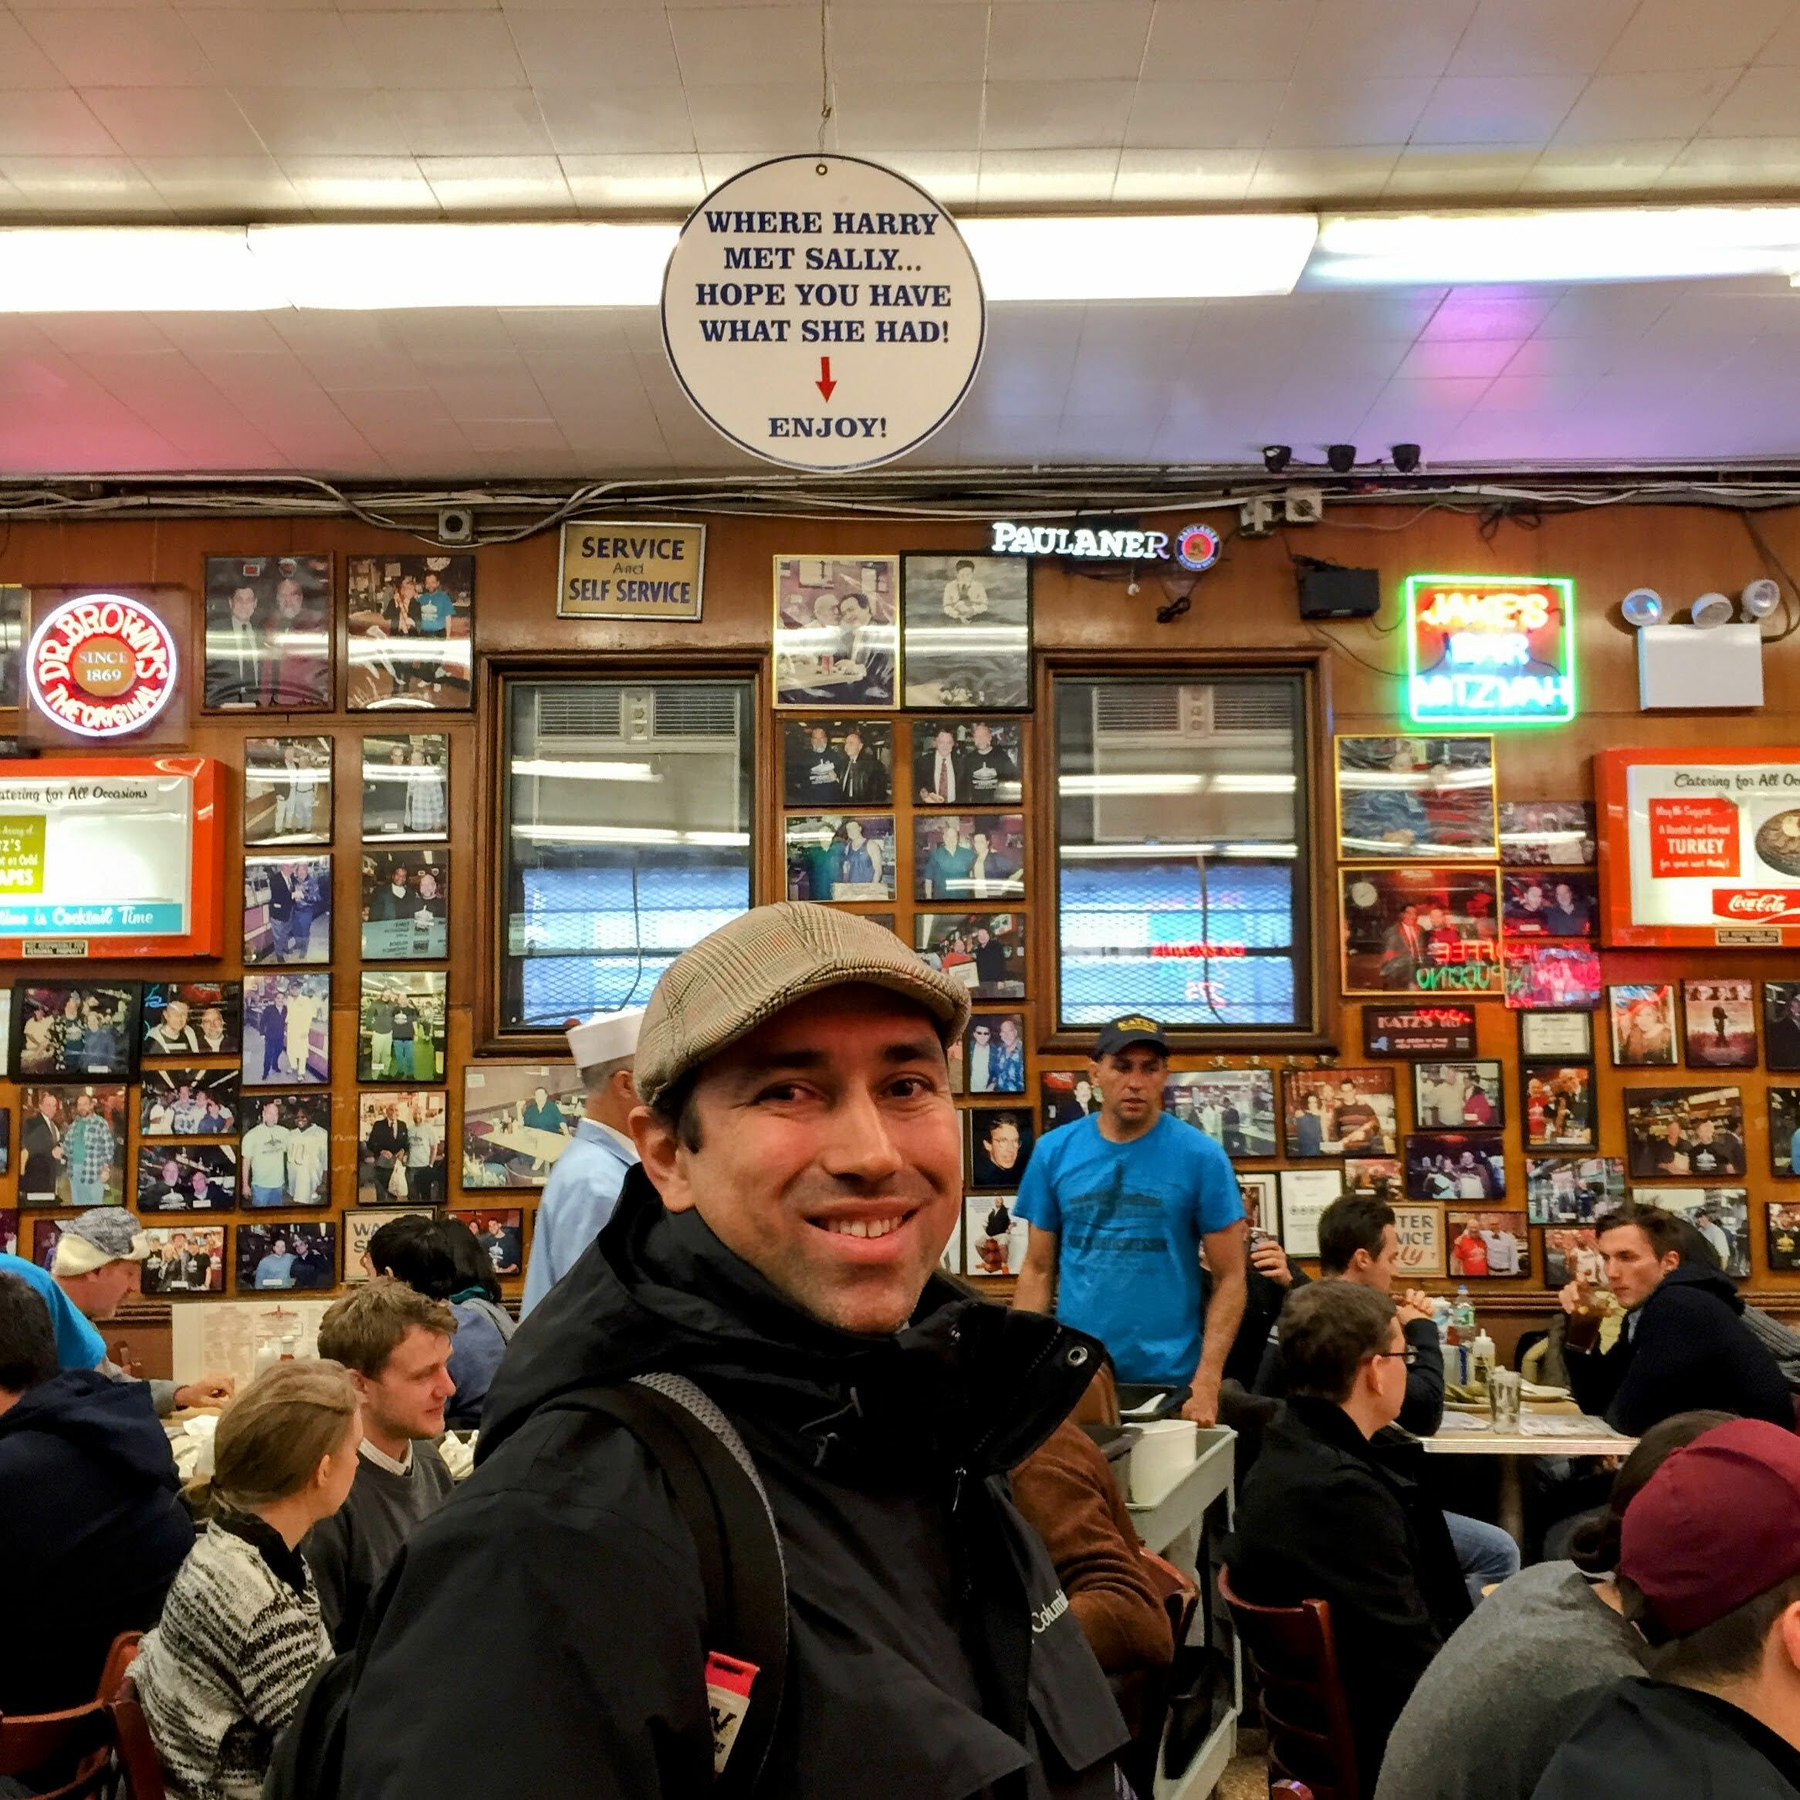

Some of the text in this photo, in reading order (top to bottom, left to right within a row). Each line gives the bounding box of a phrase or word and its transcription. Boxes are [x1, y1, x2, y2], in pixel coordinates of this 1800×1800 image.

[704, 211, 939, 235] WHERE HARRY
[724, 247, 921, 272] MET SALLY...
[695, 283, 951, 307] HOPE YOU HAVE
[699, 320, 949, 343] WHAT SHE HAD!
[768, 418, 887, 438] ENJOY!
[581, 536, 685, 560] SERVICE
[991, 522, 1170, 560] PAULANER
[612, 562, 645, 575] And
[568, 577, 691, 604] SELF SERVICE
[55, 602, 169, 681] BROWN'S
[79, 651, 128, 665] SINCE
[86, 669, 122, 682] 1869
[45, 683, 162, 729] THE ORIGINAL
[1674, 772, 1731, 790] Catering
[1736, 773, 1755, 790] for
[1759, 773, 1779, 787] All
[0, 785, 148, 803] atering for All Occasions
[1667, 838, 1725, 855] TURKEY
[33, 906, 48, 926] is
[51, 905, 114, 927] Cocktail
[117, 904, 155, 925] Time
[1396, 1215, 1434, 1229] TER
[1395, 1231, 1433, 1246] VICE
